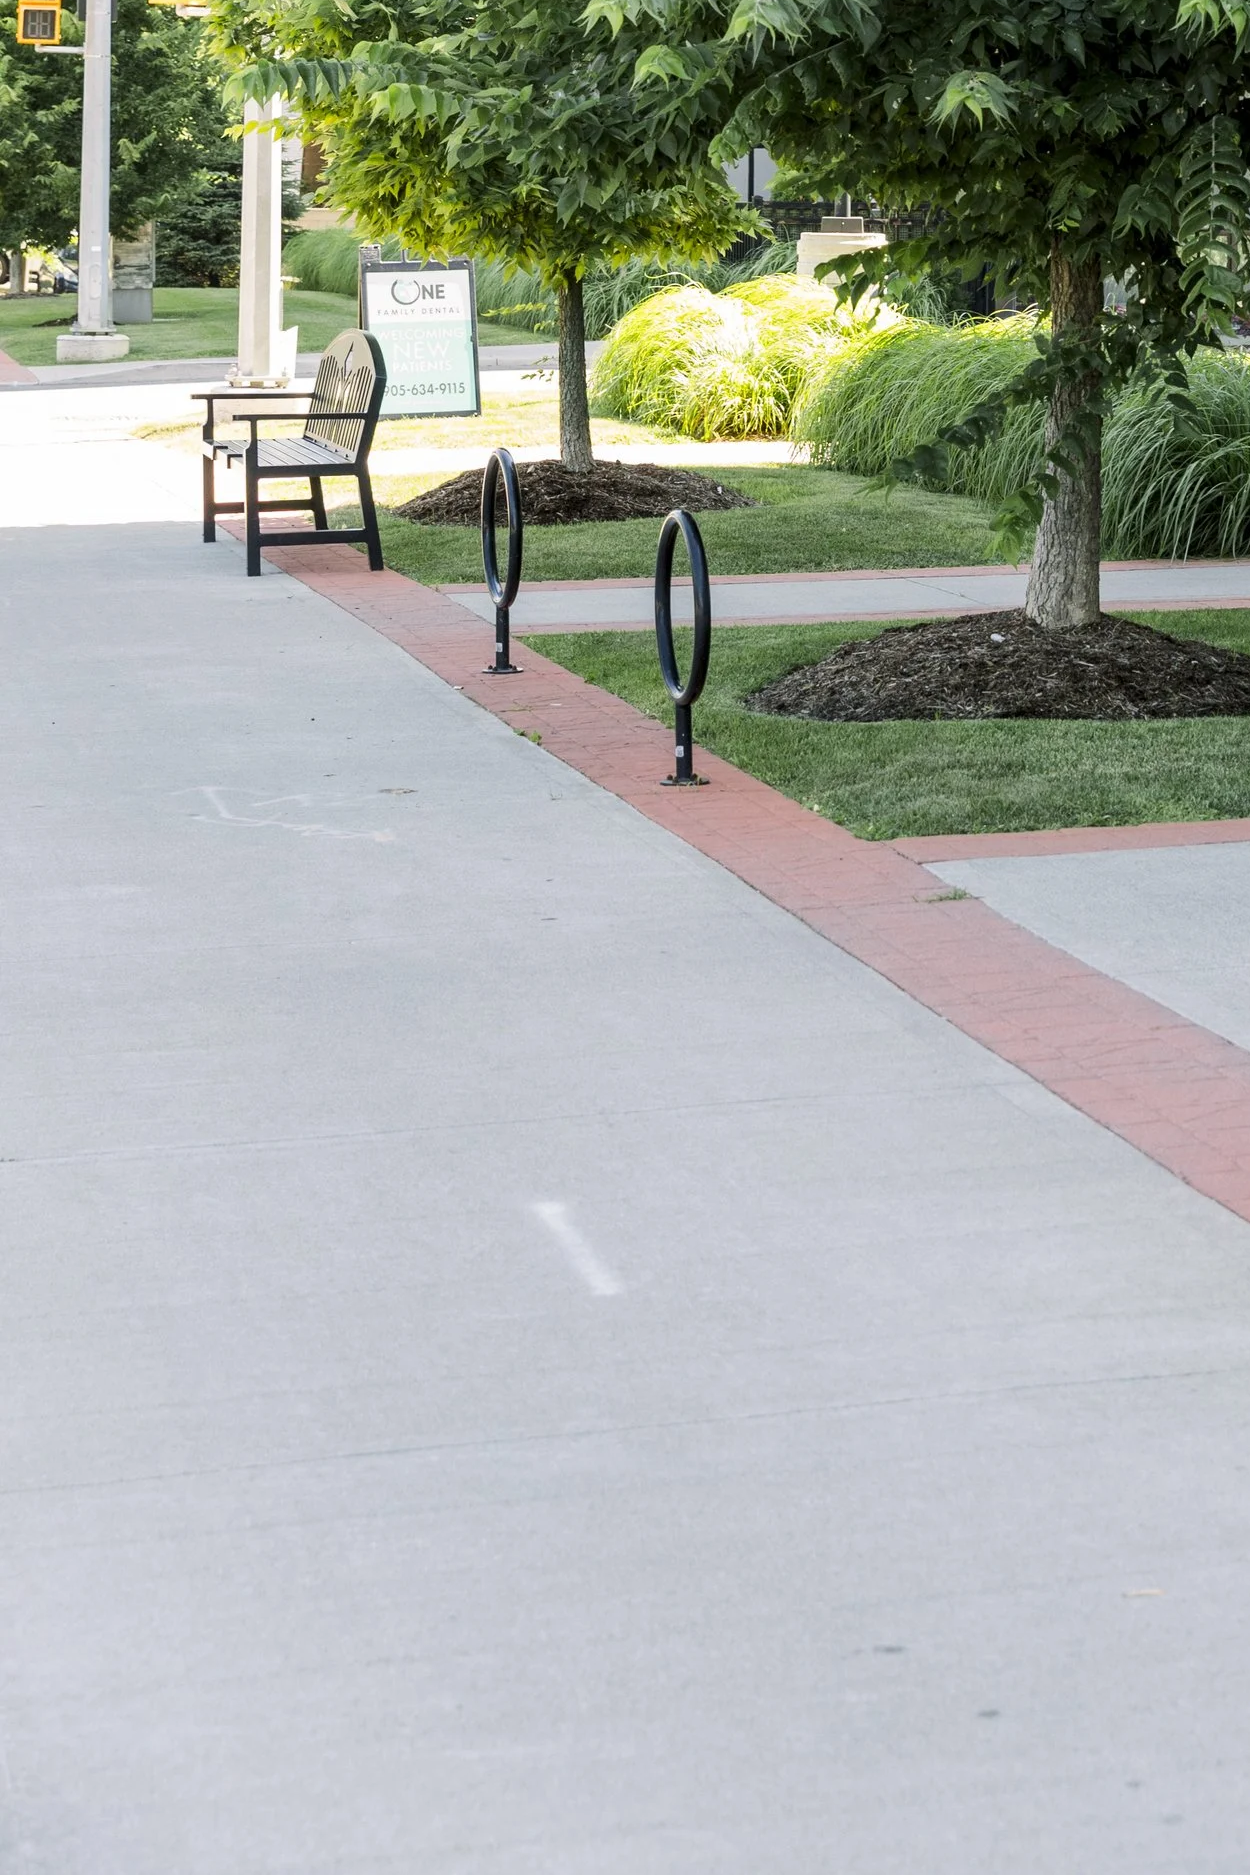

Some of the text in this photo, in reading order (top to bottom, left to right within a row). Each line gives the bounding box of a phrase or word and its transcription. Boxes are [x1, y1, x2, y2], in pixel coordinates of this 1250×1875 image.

[391, 279, 445, 305] ONE
[421, 307, 460, 315] DENTAL
[379, 328, 464, 340] WELCOMING
[394, 341, 449, 359] NEW
[392, 360, 452, 372] PATIENTS
[384, 382, 465, 396] 905-634-9115
